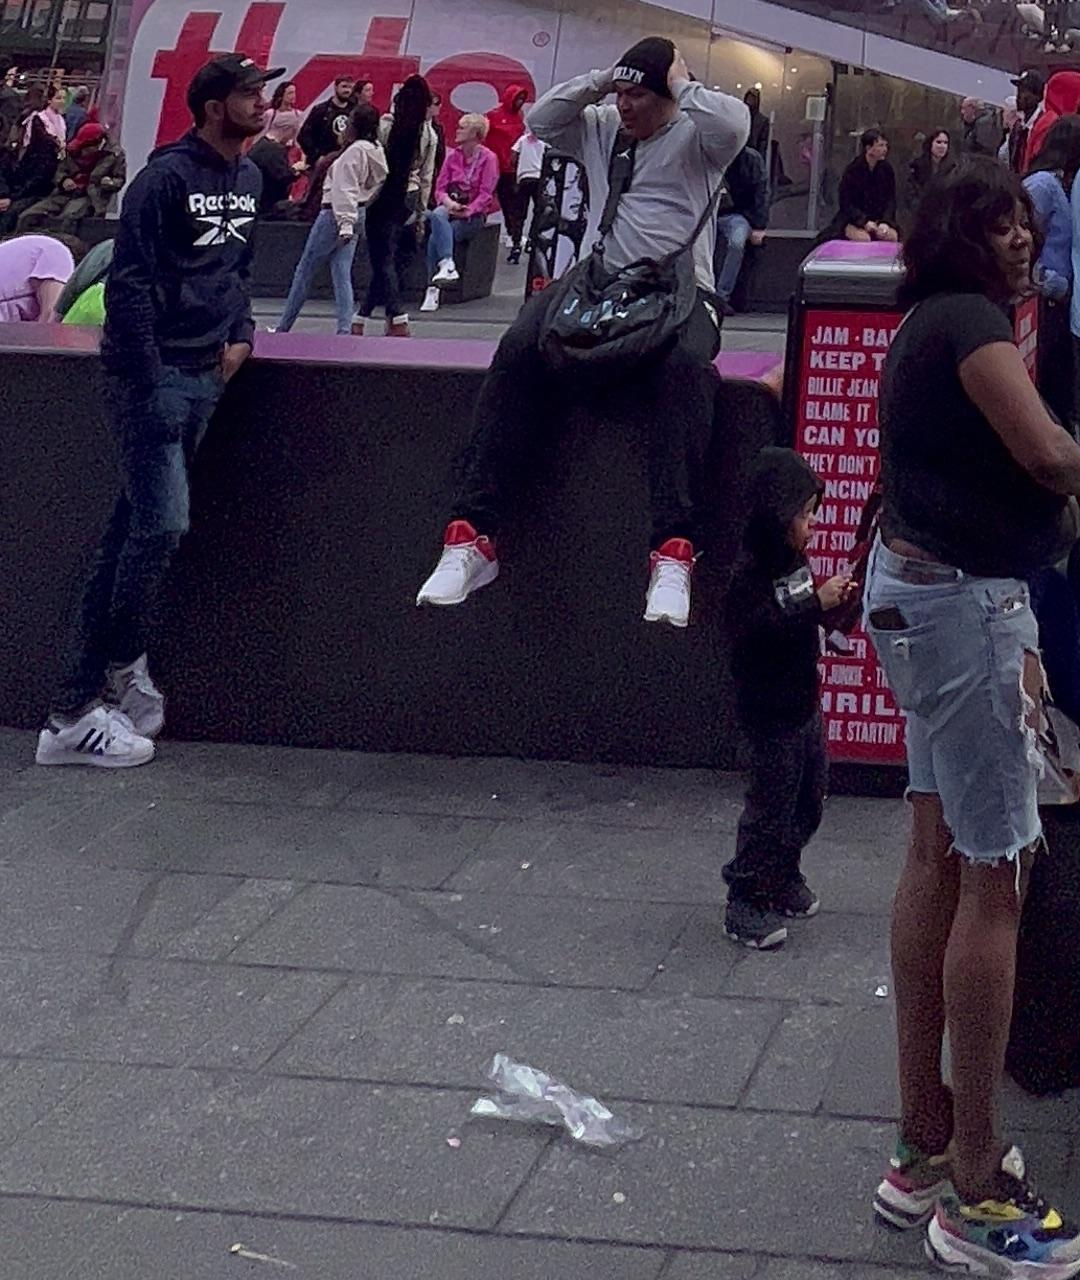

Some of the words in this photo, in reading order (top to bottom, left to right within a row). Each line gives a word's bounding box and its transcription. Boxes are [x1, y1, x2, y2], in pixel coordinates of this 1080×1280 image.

[811, 326, 850, 345] JAM
[810, 350, 867, 371] KEEP
[808, 376, 845, 397] BILLIE
[847, 378, 878, 398] JEAN
[806, 400, 850, 421] BLAME
[857, 403, 871, 422] IT
[804, 425, 845, 446] CAN
[854, 428, 880, 449] YO
[838, 455, 877, 476] DON'T
[815, 504, 838, 524] AN
